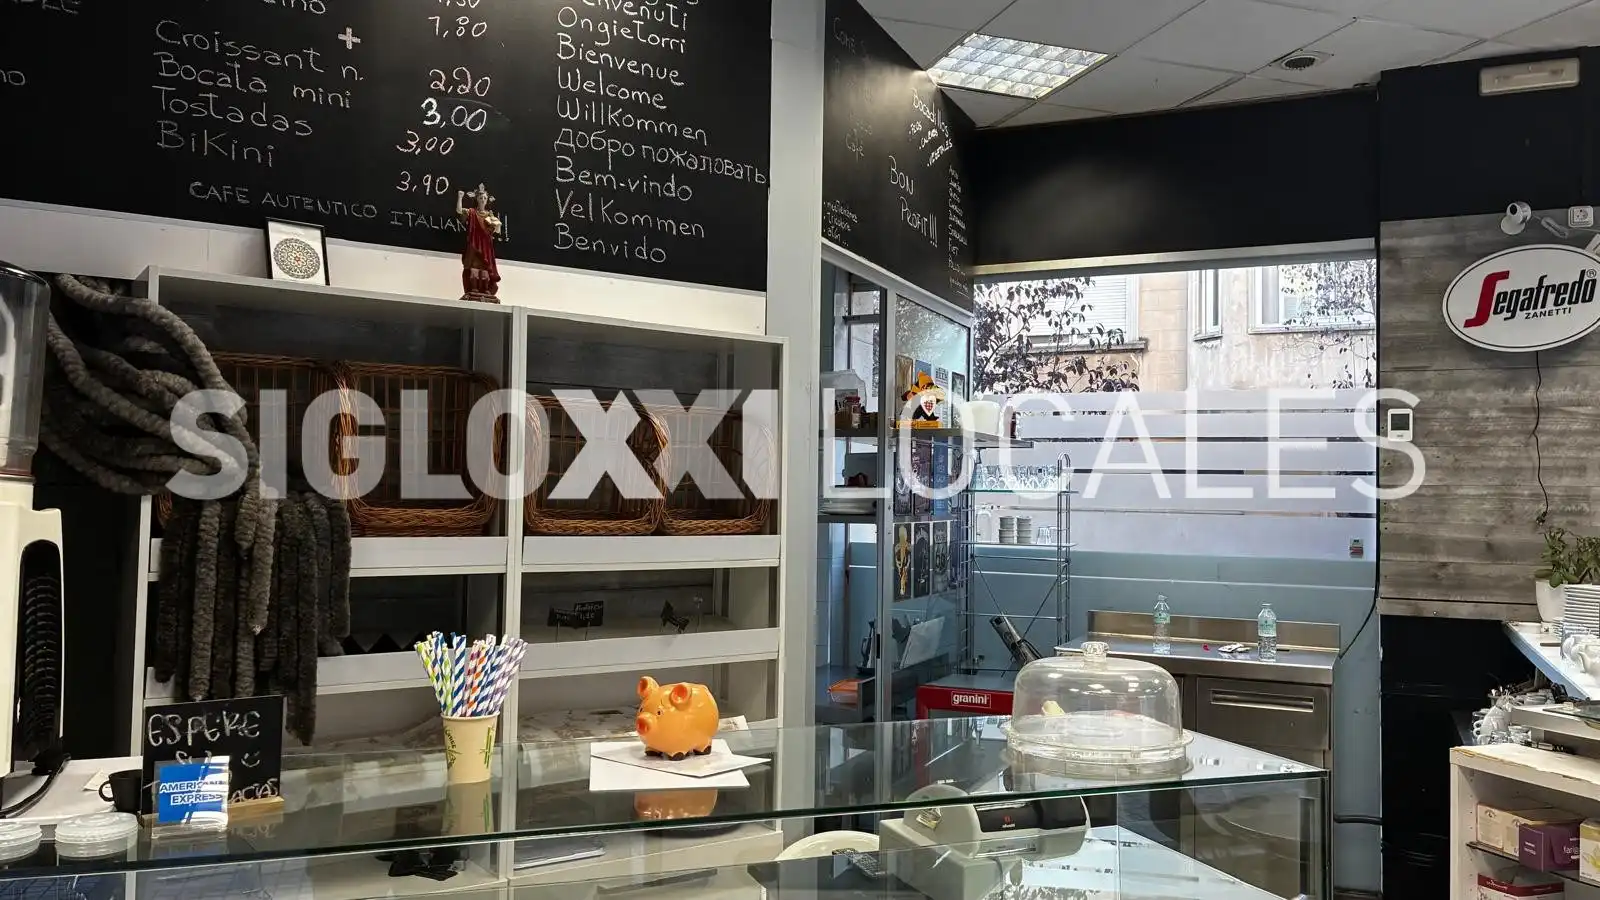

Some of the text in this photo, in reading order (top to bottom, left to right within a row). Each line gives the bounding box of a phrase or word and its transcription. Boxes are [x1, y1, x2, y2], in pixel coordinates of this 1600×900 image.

[156, 20, 325, 73] Croissant
[556, 33, 685, 87] Bienvenue
[293, 83, 352, 109] mini
[429, 66, 491, 98] 2,20
[557, 66, 668, 110] Welcome
[152, 85, 313, 137] Tostadas
[421, 97, 488, 132] 3,00
[396, 129, 455, 155] 3,00
[396, 170, 450, 196] 3,90
[555, 155, 693, 201] Bem-vindo
[641, 144, 767, 184] пожаловать
[189, 181, 251, 205] CAFE
[262, 191, 378, 219] AUTENTICO
[554, 222, 667, 263] Benvido
[1463, 268, 1598, 329] Segafredo
[1524, 306, 1572, 320] ZANETTI
[952, 693, 988, 706] granini
